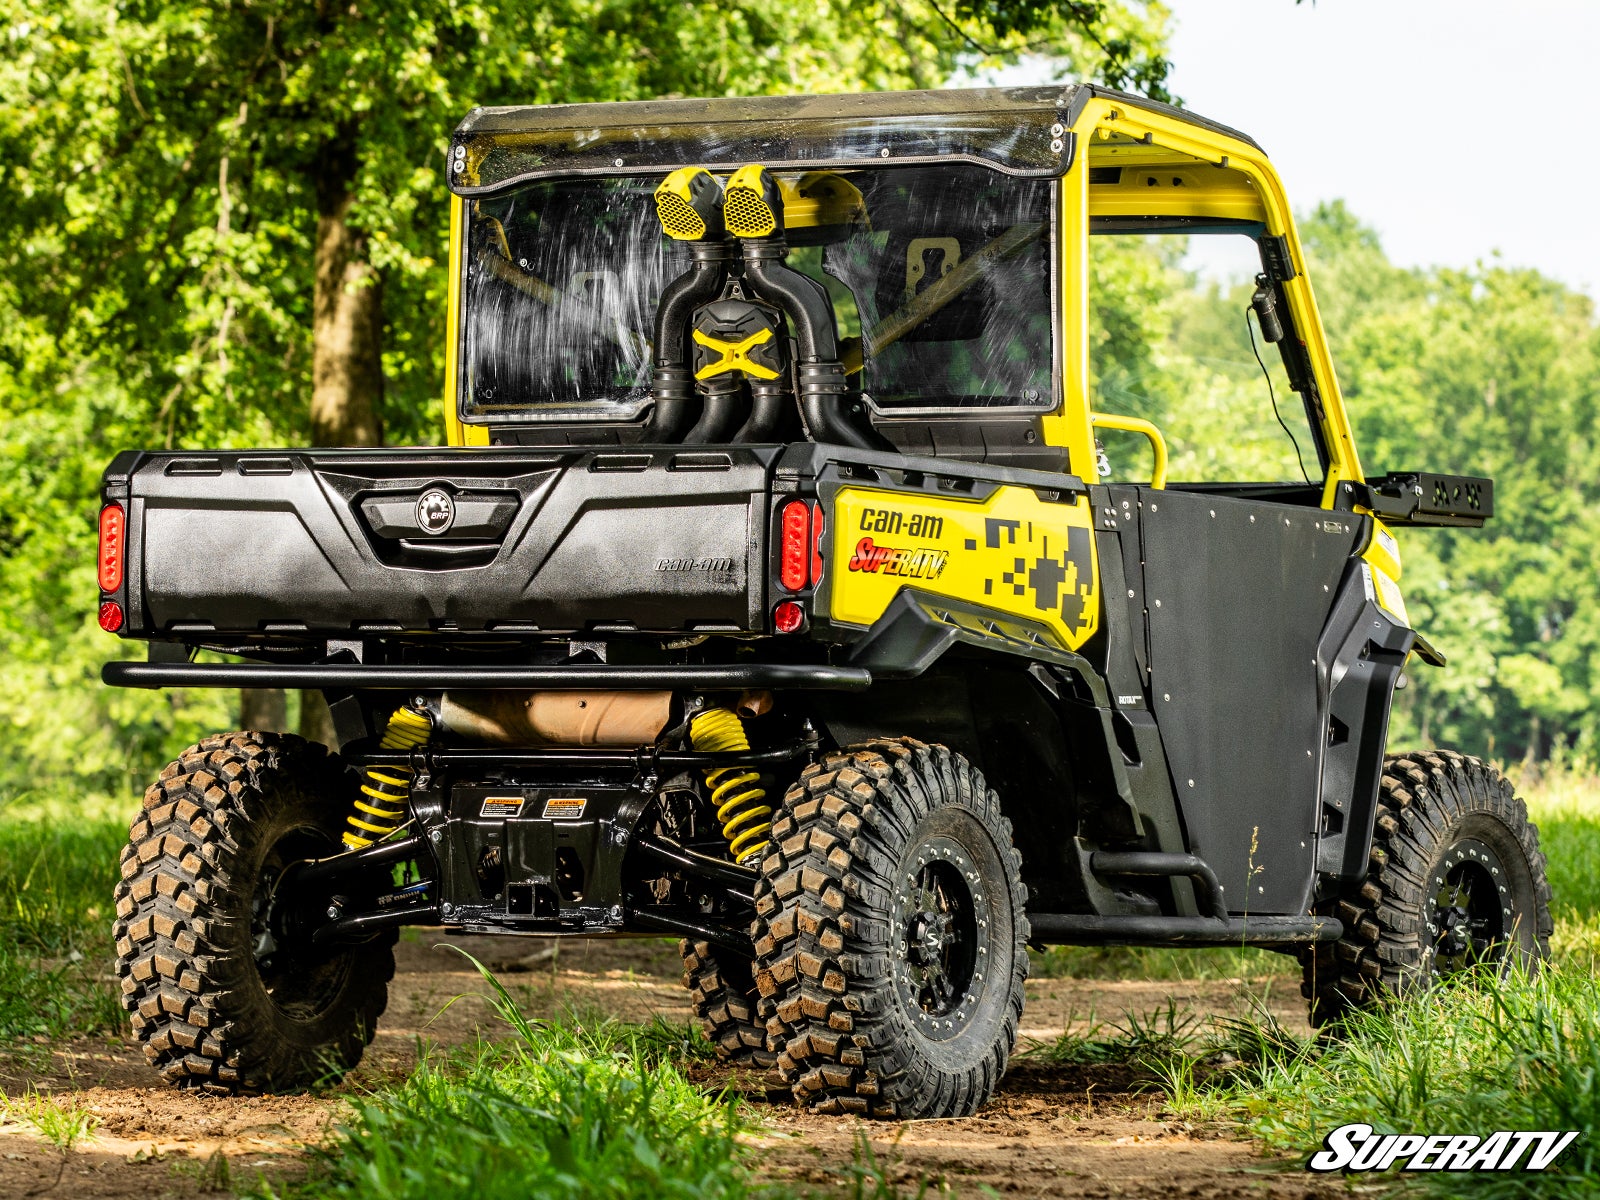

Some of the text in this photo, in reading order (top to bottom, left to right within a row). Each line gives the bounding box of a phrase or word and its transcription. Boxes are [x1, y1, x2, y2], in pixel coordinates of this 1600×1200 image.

[431, 512, 449, 520] BRP
[860, 508, 943, 539] can-am
[655, 558, 732, 572] can-am
[849, 537, 949, 579] SUPERATV
